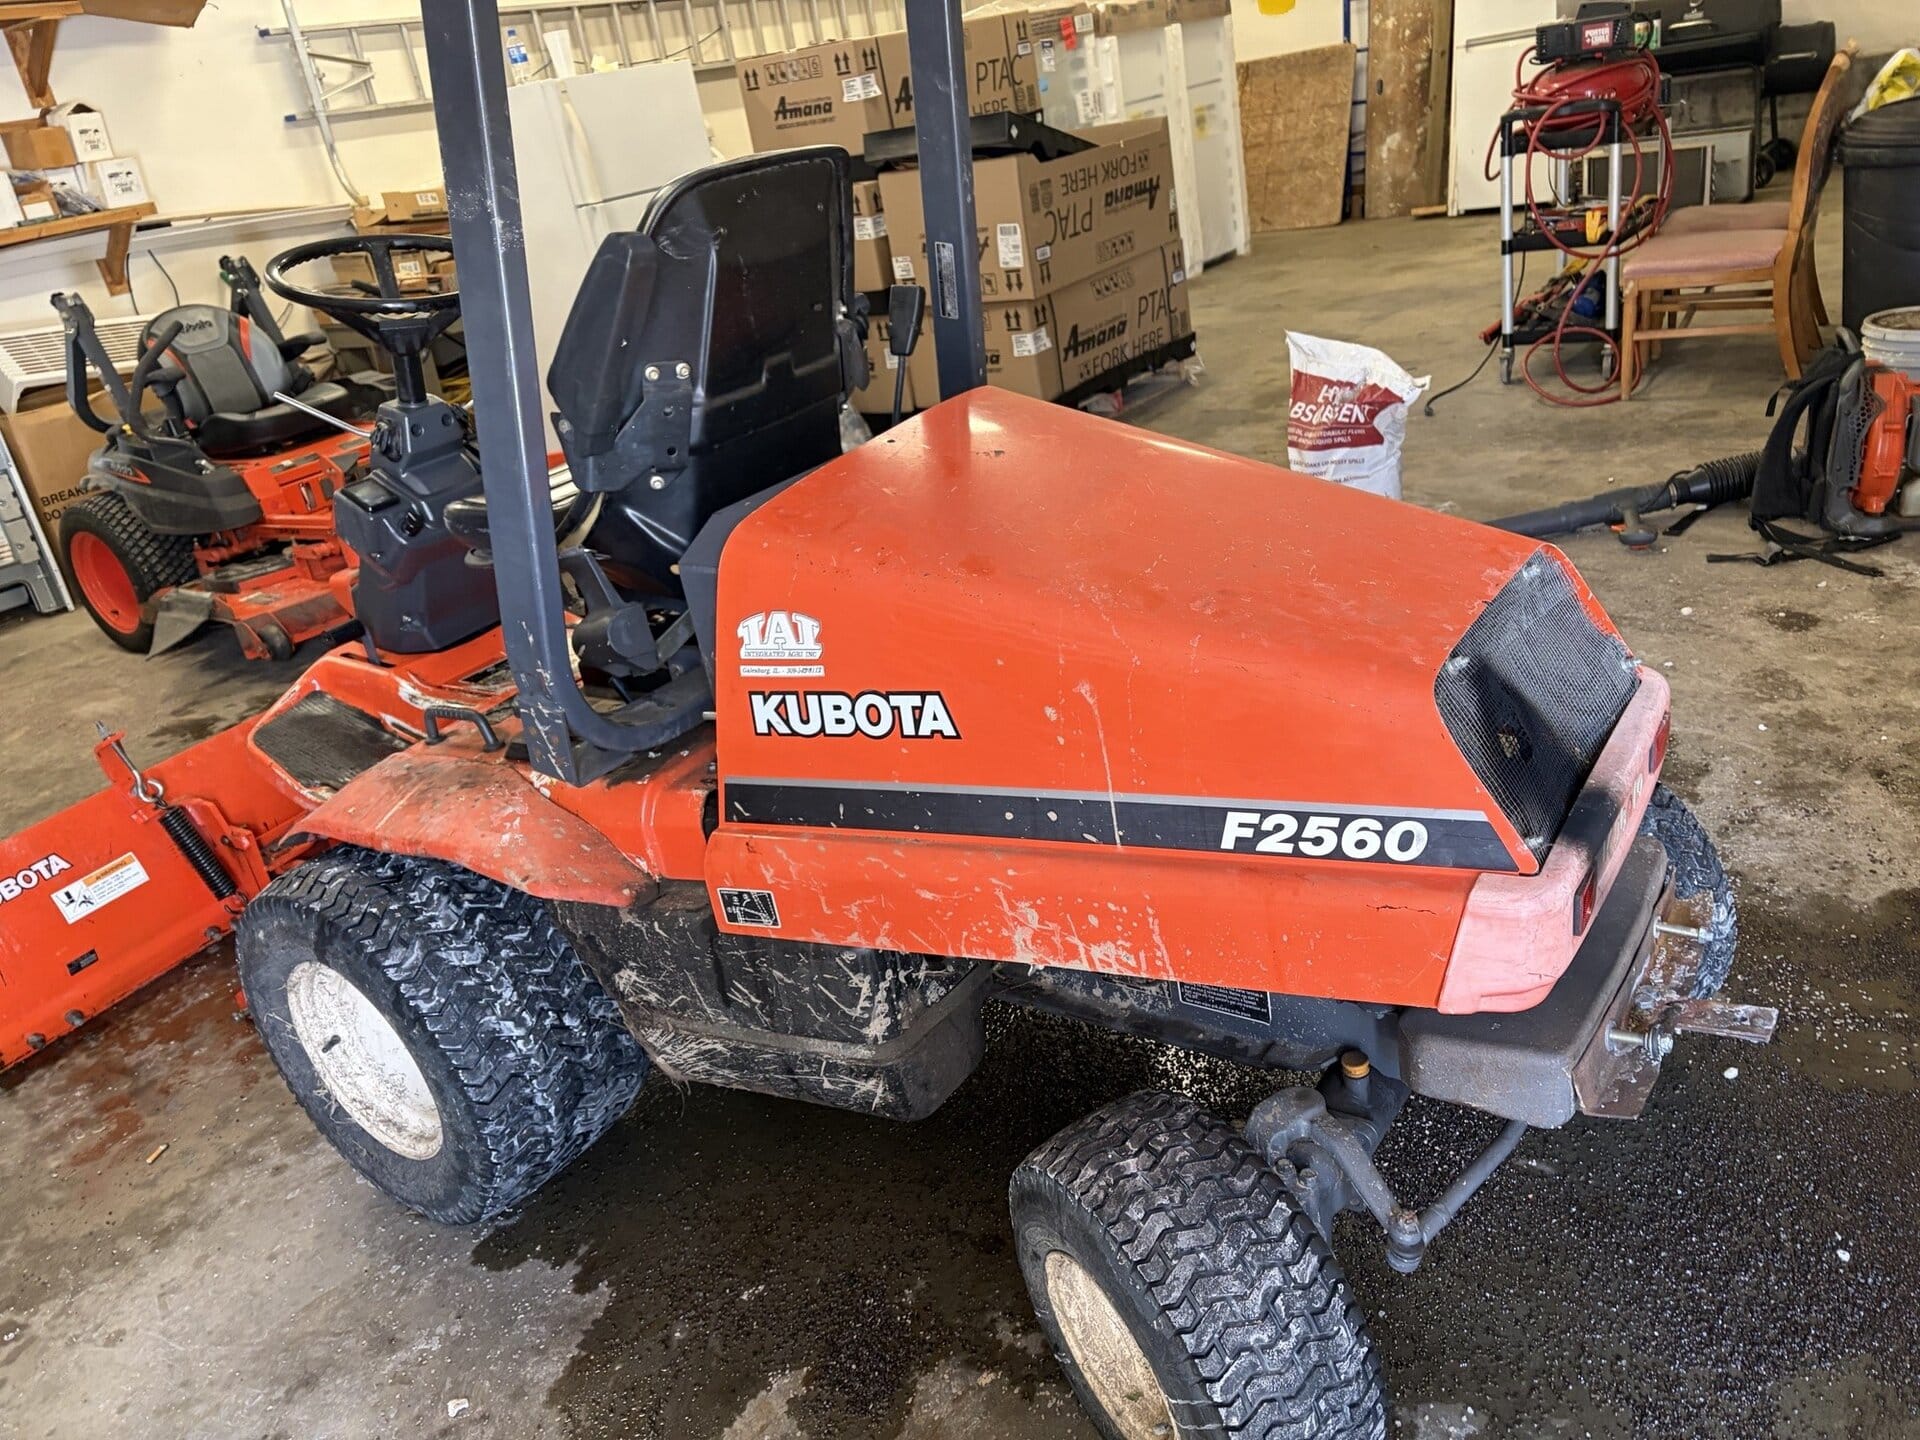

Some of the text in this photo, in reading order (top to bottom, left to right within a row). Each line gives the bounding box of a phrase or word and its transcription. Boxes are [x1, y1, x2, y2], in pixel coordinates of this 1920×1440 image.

[976, 54, 1024, 95] PTAC
[774, 96, 833, 121] Amana
[1060, 152, 1137, 197] FORK HERE
[1104, 174, 1160, 210] Amana
[1044, 197, 1093, 246] PTAC
[1137, 283, 1178, 328] PTAC
[1063, 320, 1128, 362] Amana
[1093, 327, 1163, 374] FORK HERE
[739, 610, 822, 650] IAI
[748, 690, 962, 740] KUBOTA
[1220, 811, 1429, 862] F2560
[0, 853, 73, 904] BOTA
